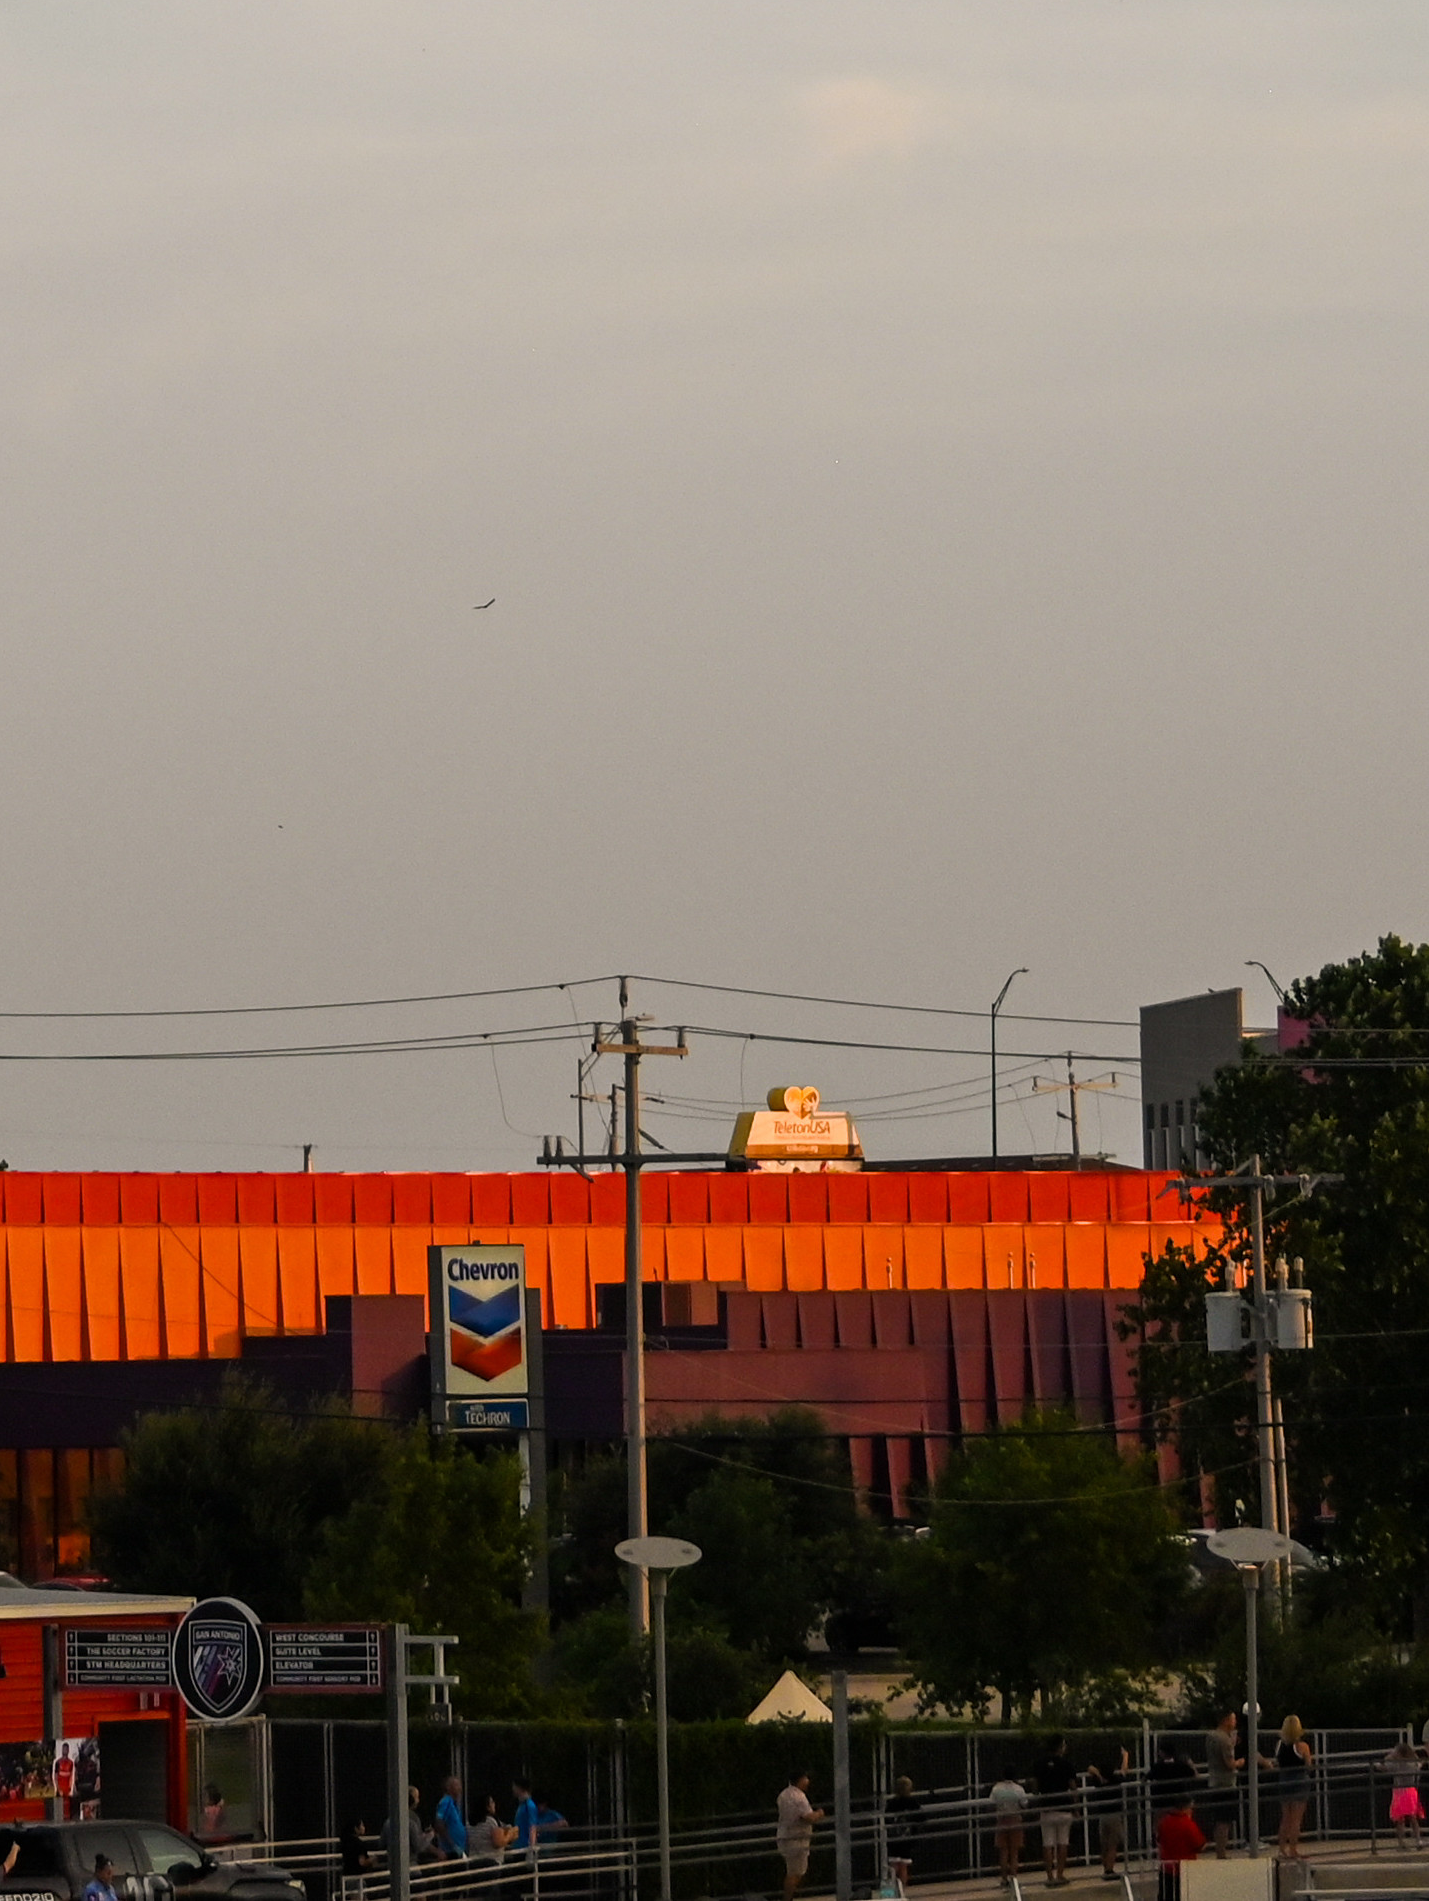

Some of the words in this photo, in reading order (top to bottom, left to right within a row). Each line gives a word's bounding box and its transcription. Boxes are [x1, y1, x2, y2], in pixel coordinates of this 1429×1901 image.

[447, 1257, 519, 1282] Chevron
[465, 1410, 511, 1426] TECHRON
[107, 1633, 143, 1642] SECTIONS
[195, 1630, 209, 1639] SAN
[211, 1630, 240, 1641] ANTONIO
[275, 1633, 296, 1642] WEST
[297, 1633, 344, 1642] CONCOURSE
[87, 1647, 101, 1655] THE
[102, 1647, 131, 1656] SOCCER
[132, 1647, 165, 1656] FACTORY
[275, 1647, 296, 1656] SUITE
[298, 1647, 322, 1656] LEVEL
[104, 1660, 166, 1669] HEADQUARTERS
[275, 1661, 314, 1669] ELEVATOR
